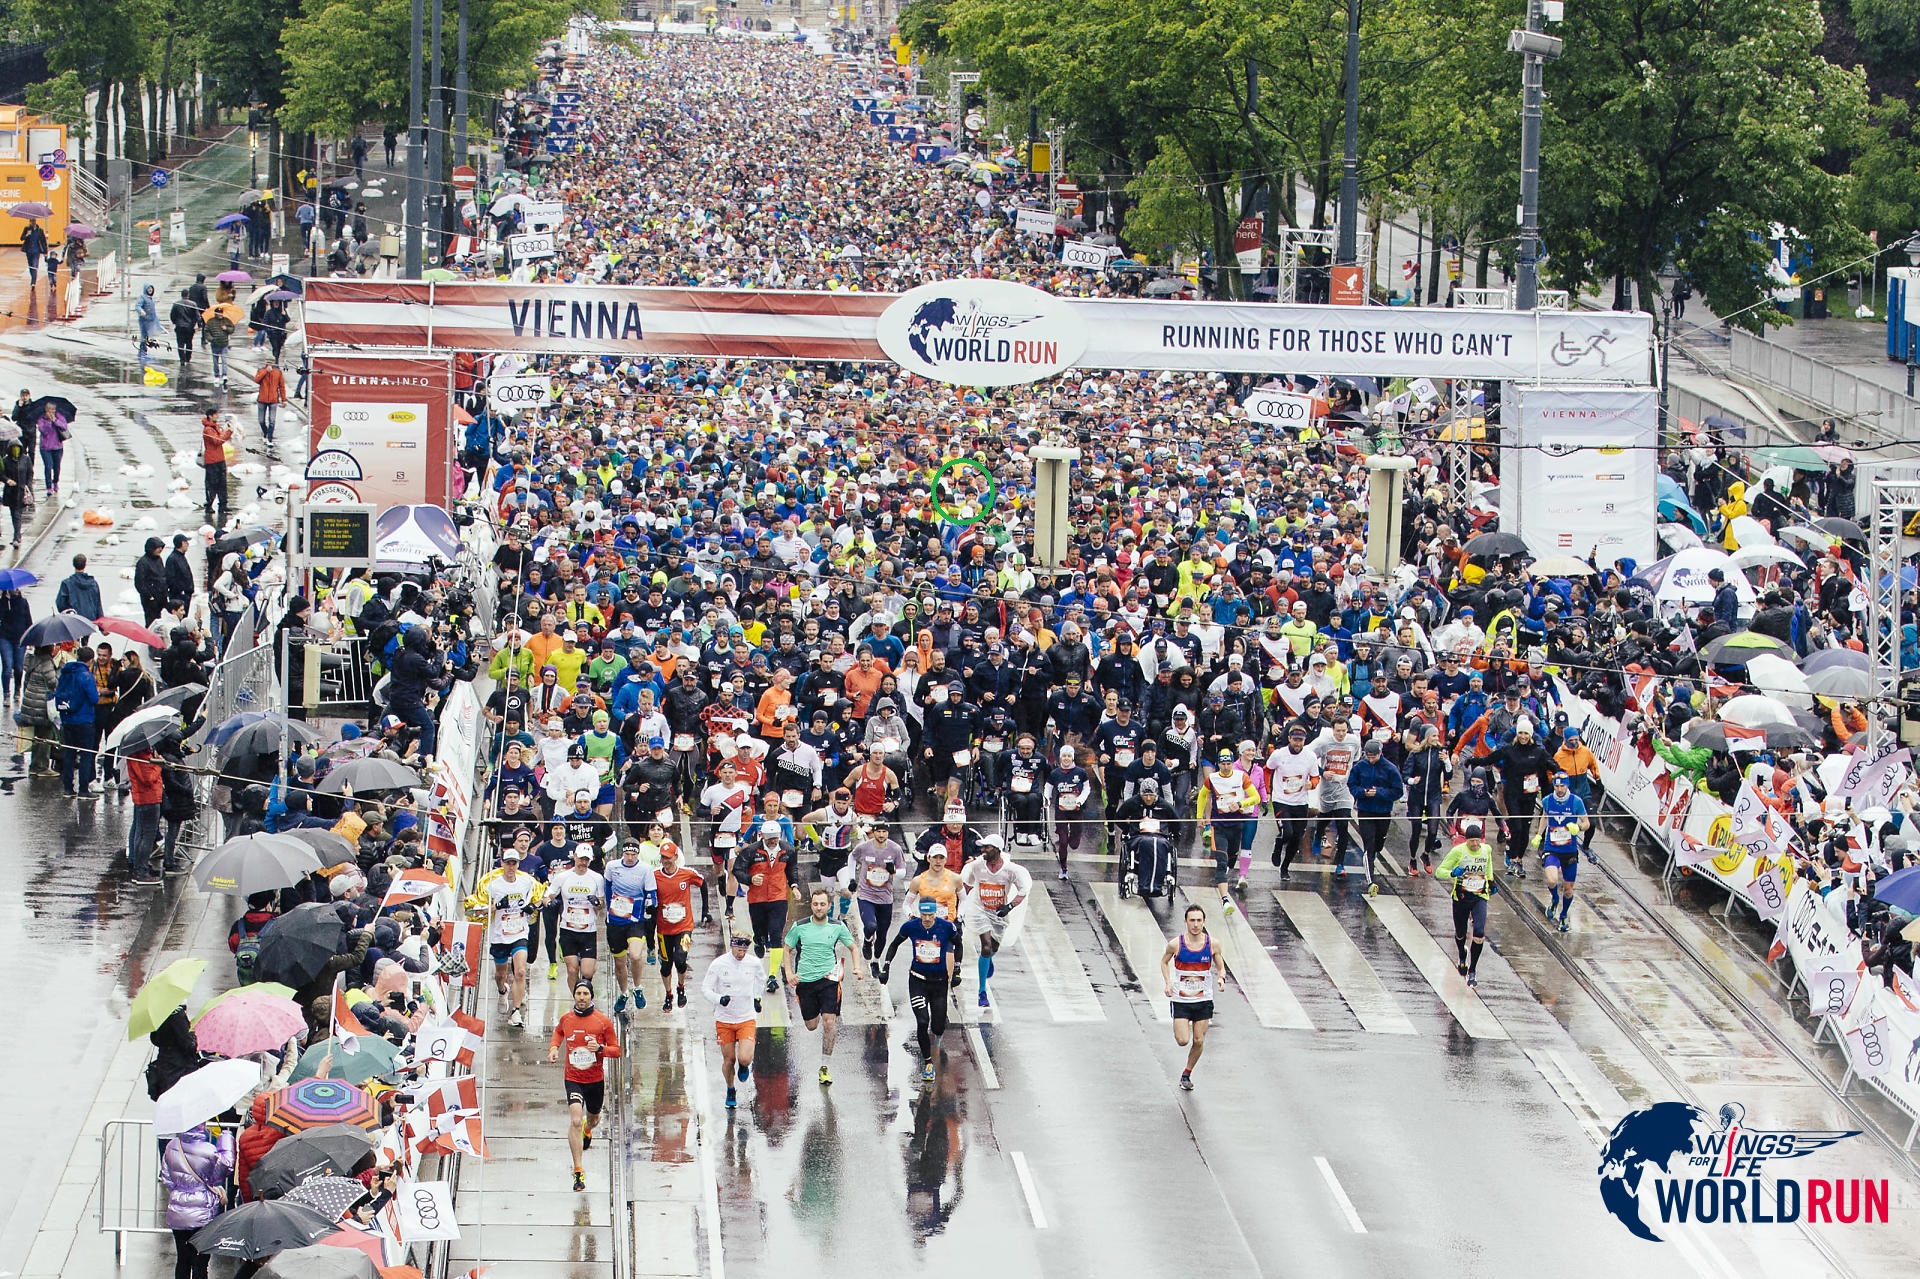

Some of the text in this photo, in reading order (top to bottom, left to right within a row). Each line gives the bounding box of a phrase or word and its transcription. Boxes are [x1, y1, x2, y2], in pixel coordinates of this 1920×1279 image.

[1018, 216, 1054, 225] e-tron
[1236, 230, 1258, 239] here.
[508, 298, 643, 340] VIENNA
[956, 311, 1009, 328] WINGS
[962, 326, 993, 338] LIFE
[1162, 325, 1513, 357] RUNNING FOR THOSE WHO CAN'T
[933, 337, 1057, 365] WORLD RUN
[332, 375, 429, 387] VIENNA.INFO
[318, 453, 351, 464] AUTOBUS
[312, 486, 355, 501] STRASSENBAHN
[569, 823, 584, 831] beat
[578, 825, 594, 835] your
[571, 832, 591, 841] limits
